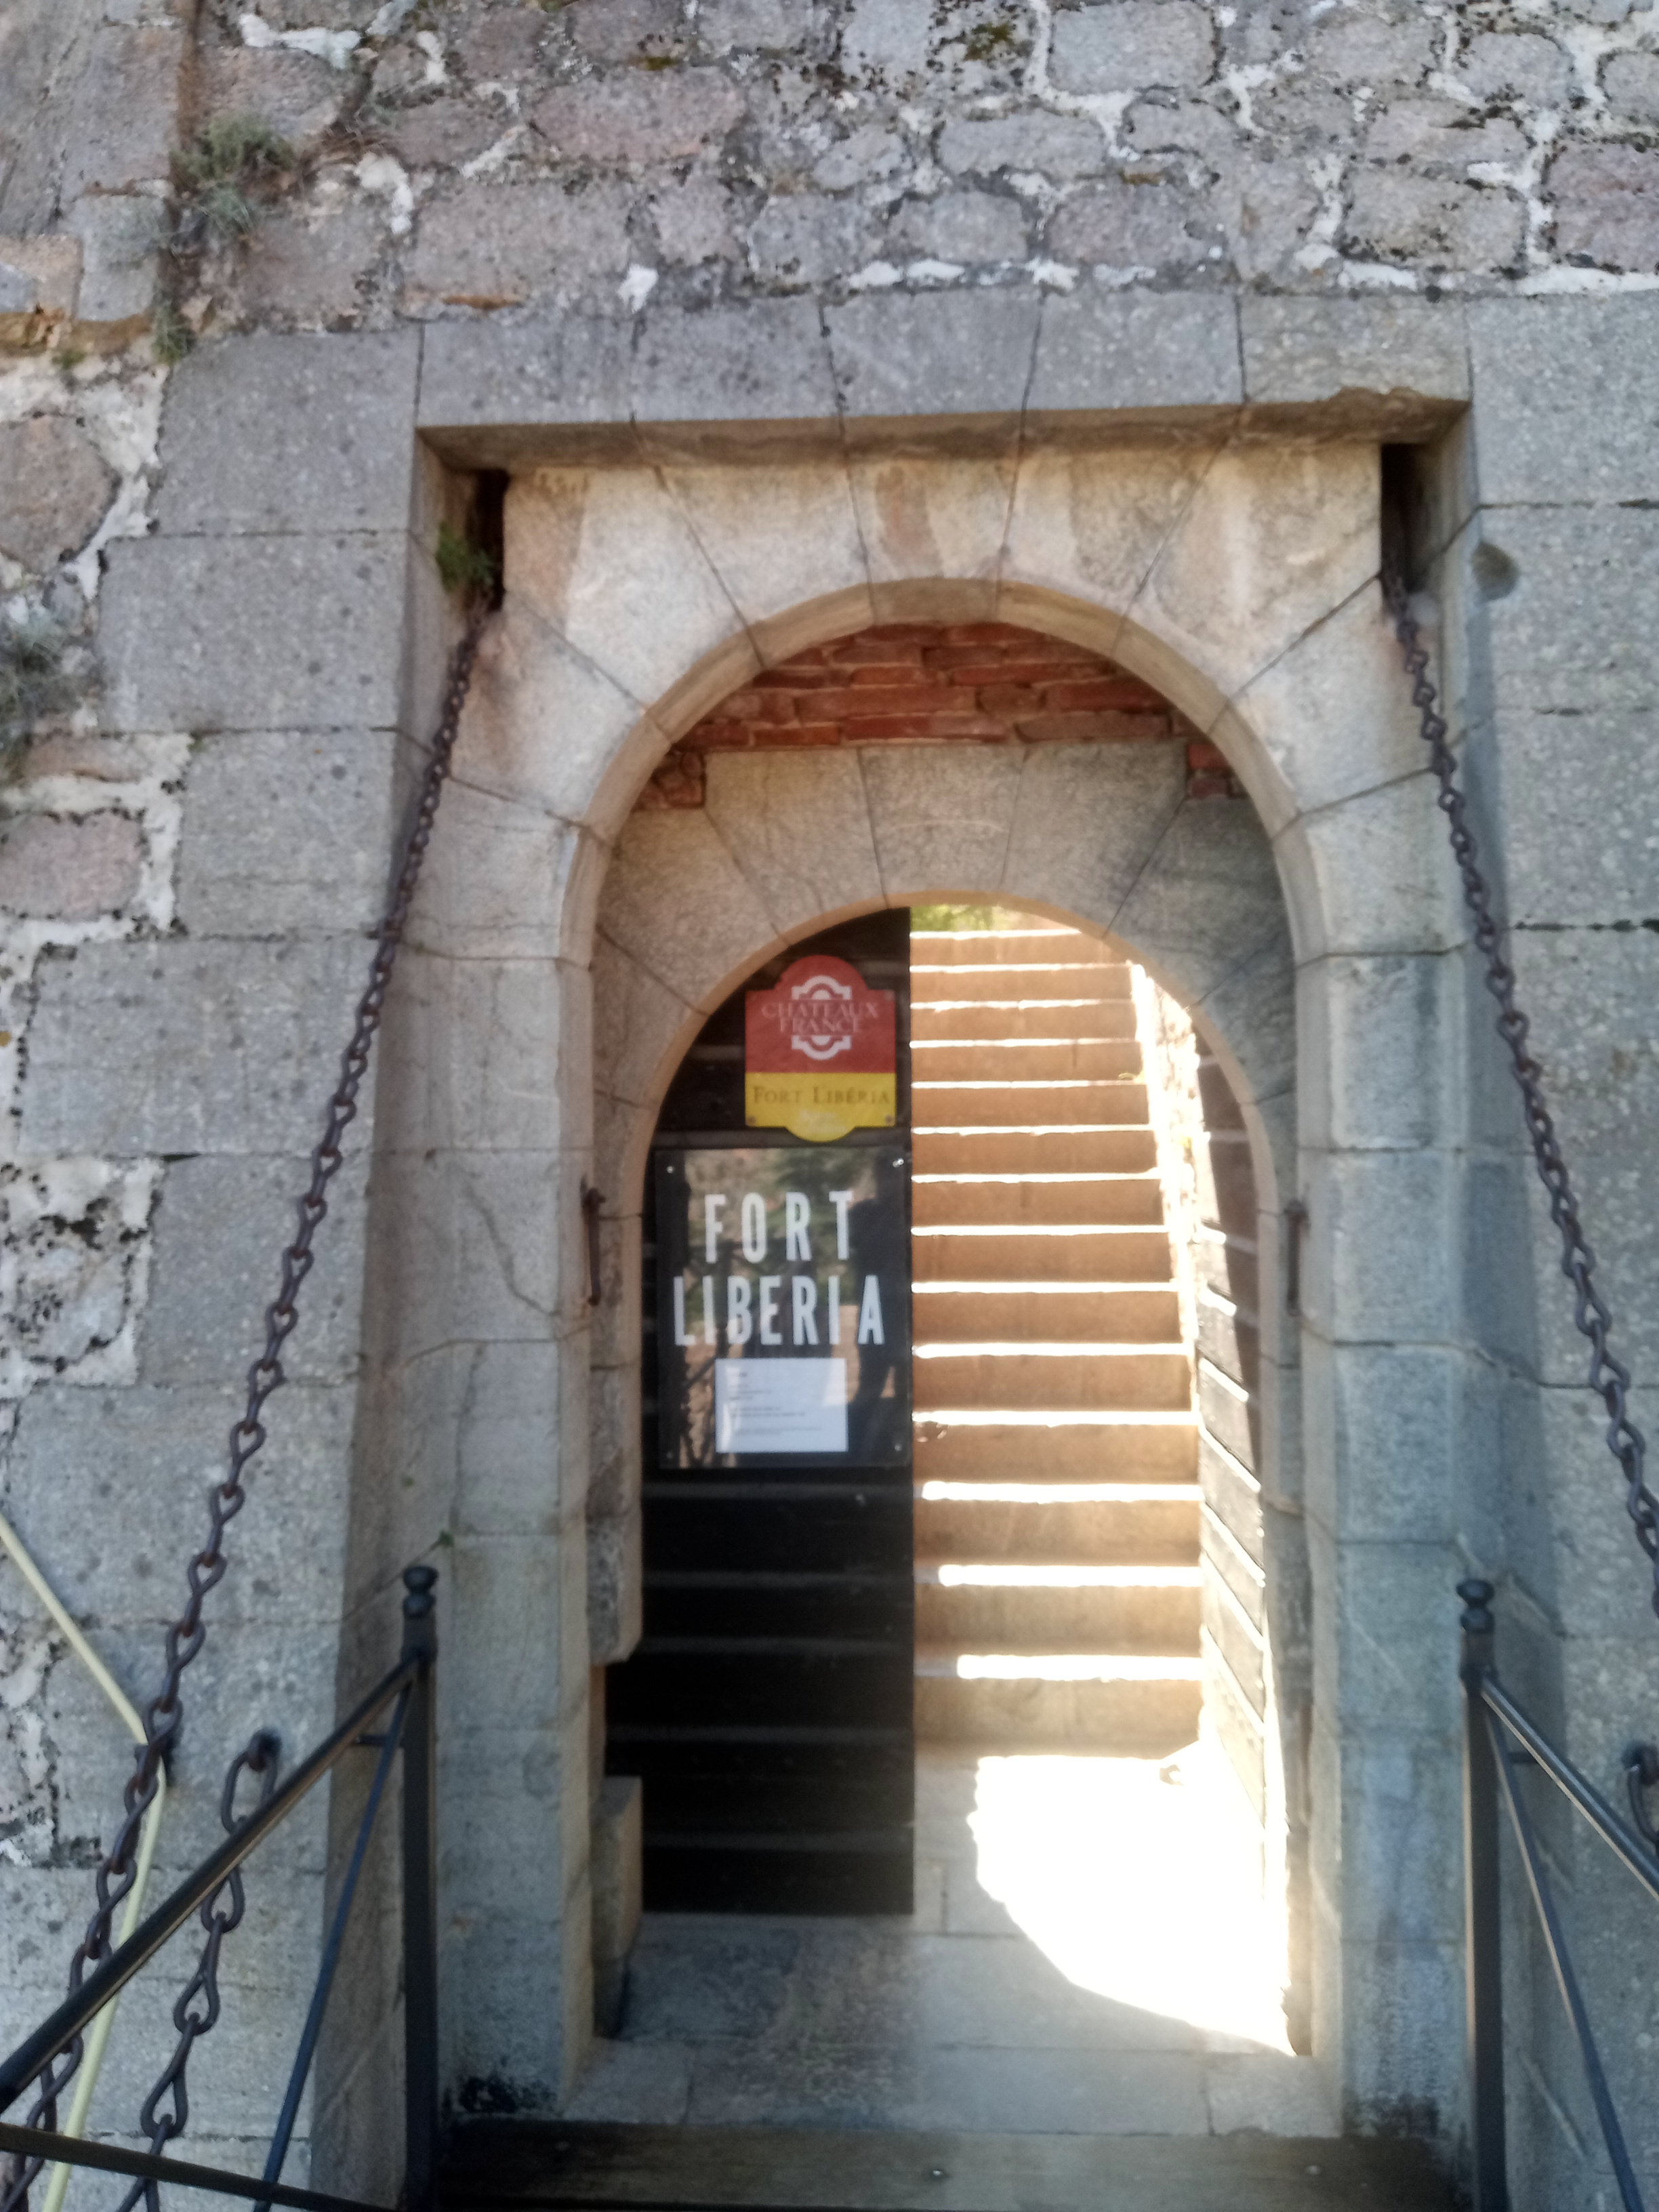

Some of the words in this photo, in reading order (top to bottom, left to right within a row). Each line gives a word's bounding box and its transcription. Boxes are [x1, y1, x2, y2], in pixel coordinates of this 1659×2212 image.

[780, 1017, 861, 1033] FRANCE
[753, 1086, 802, 1104] FORT
[704, 1190, 853, 1265] FORT
[673, 1274, 886, 1347] LIBERIA
